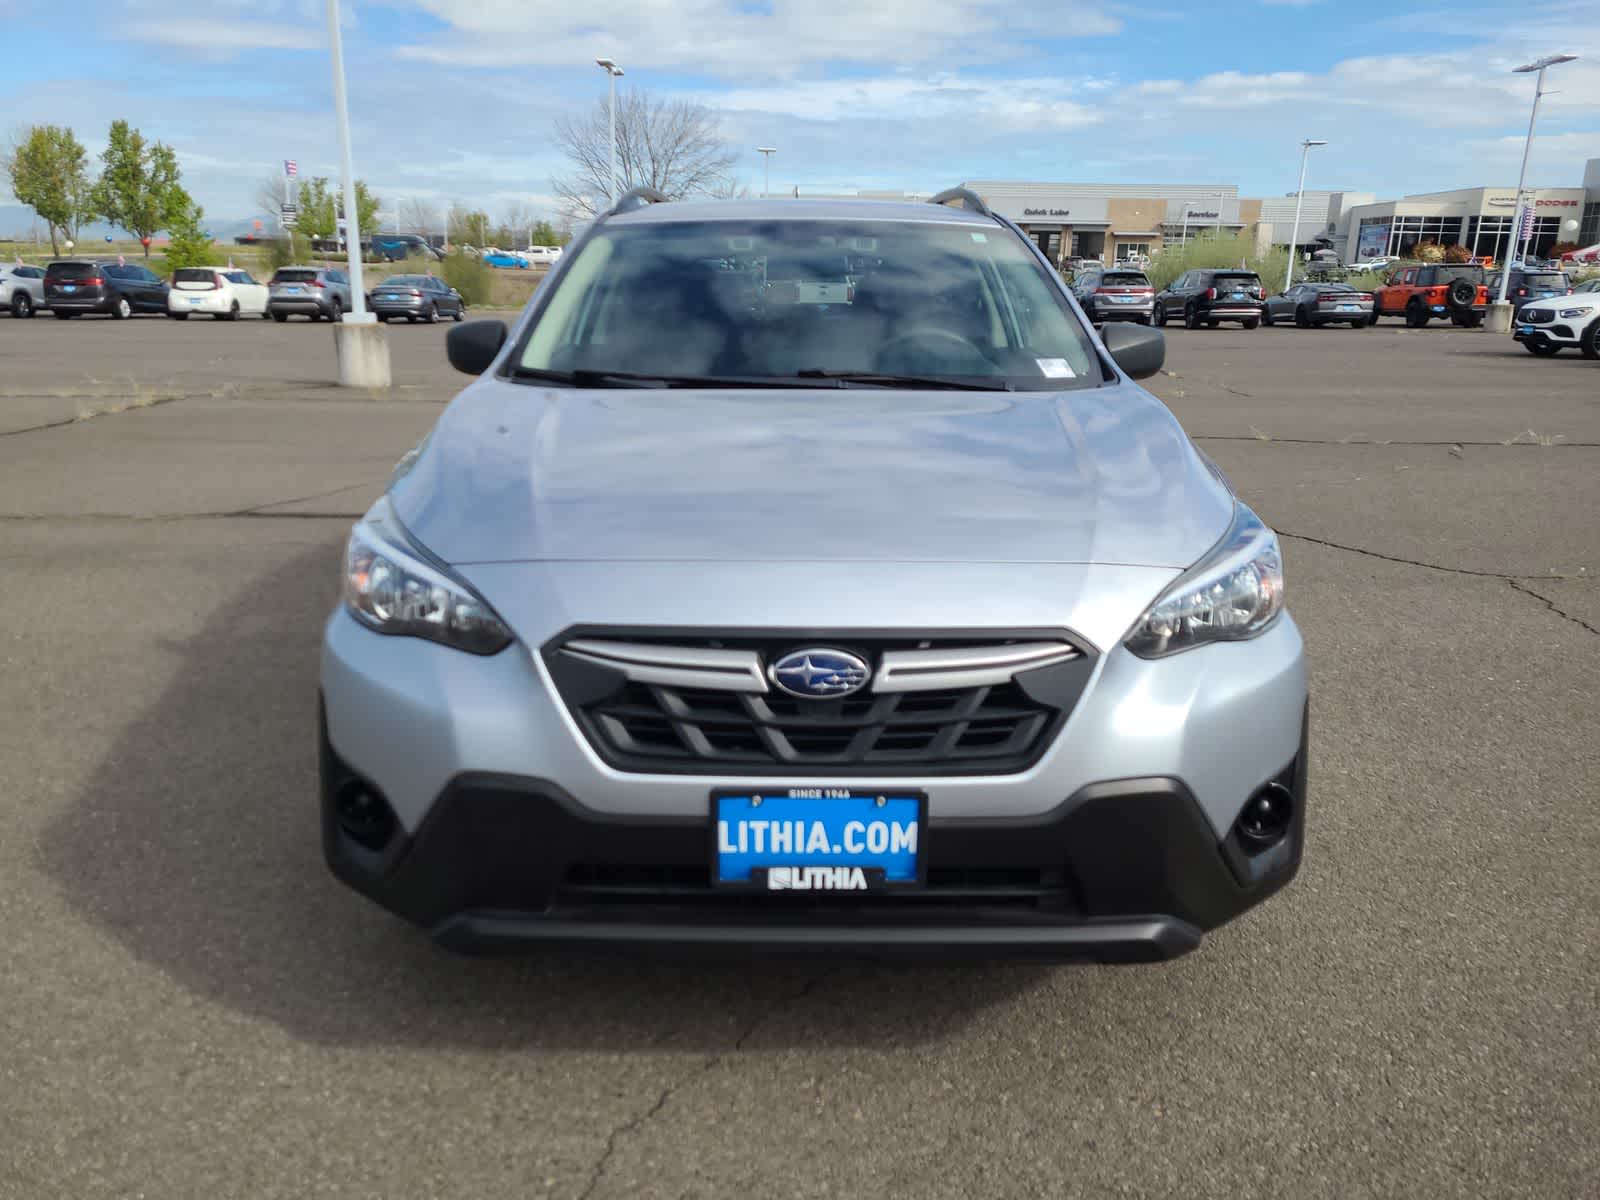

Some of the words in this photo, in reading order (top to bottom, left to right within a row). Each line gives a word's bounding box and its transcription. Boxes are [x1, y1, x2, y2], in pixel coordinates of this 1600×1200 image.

[1535, 199, 1578, 207] DODGE
[1024, 208, 1048, 216] Quick
[788, 789, 822, 799] SINCE
[718, 820, 918, 854] LITHIA.COM
[791, 867, 868, 890] LITHIA
